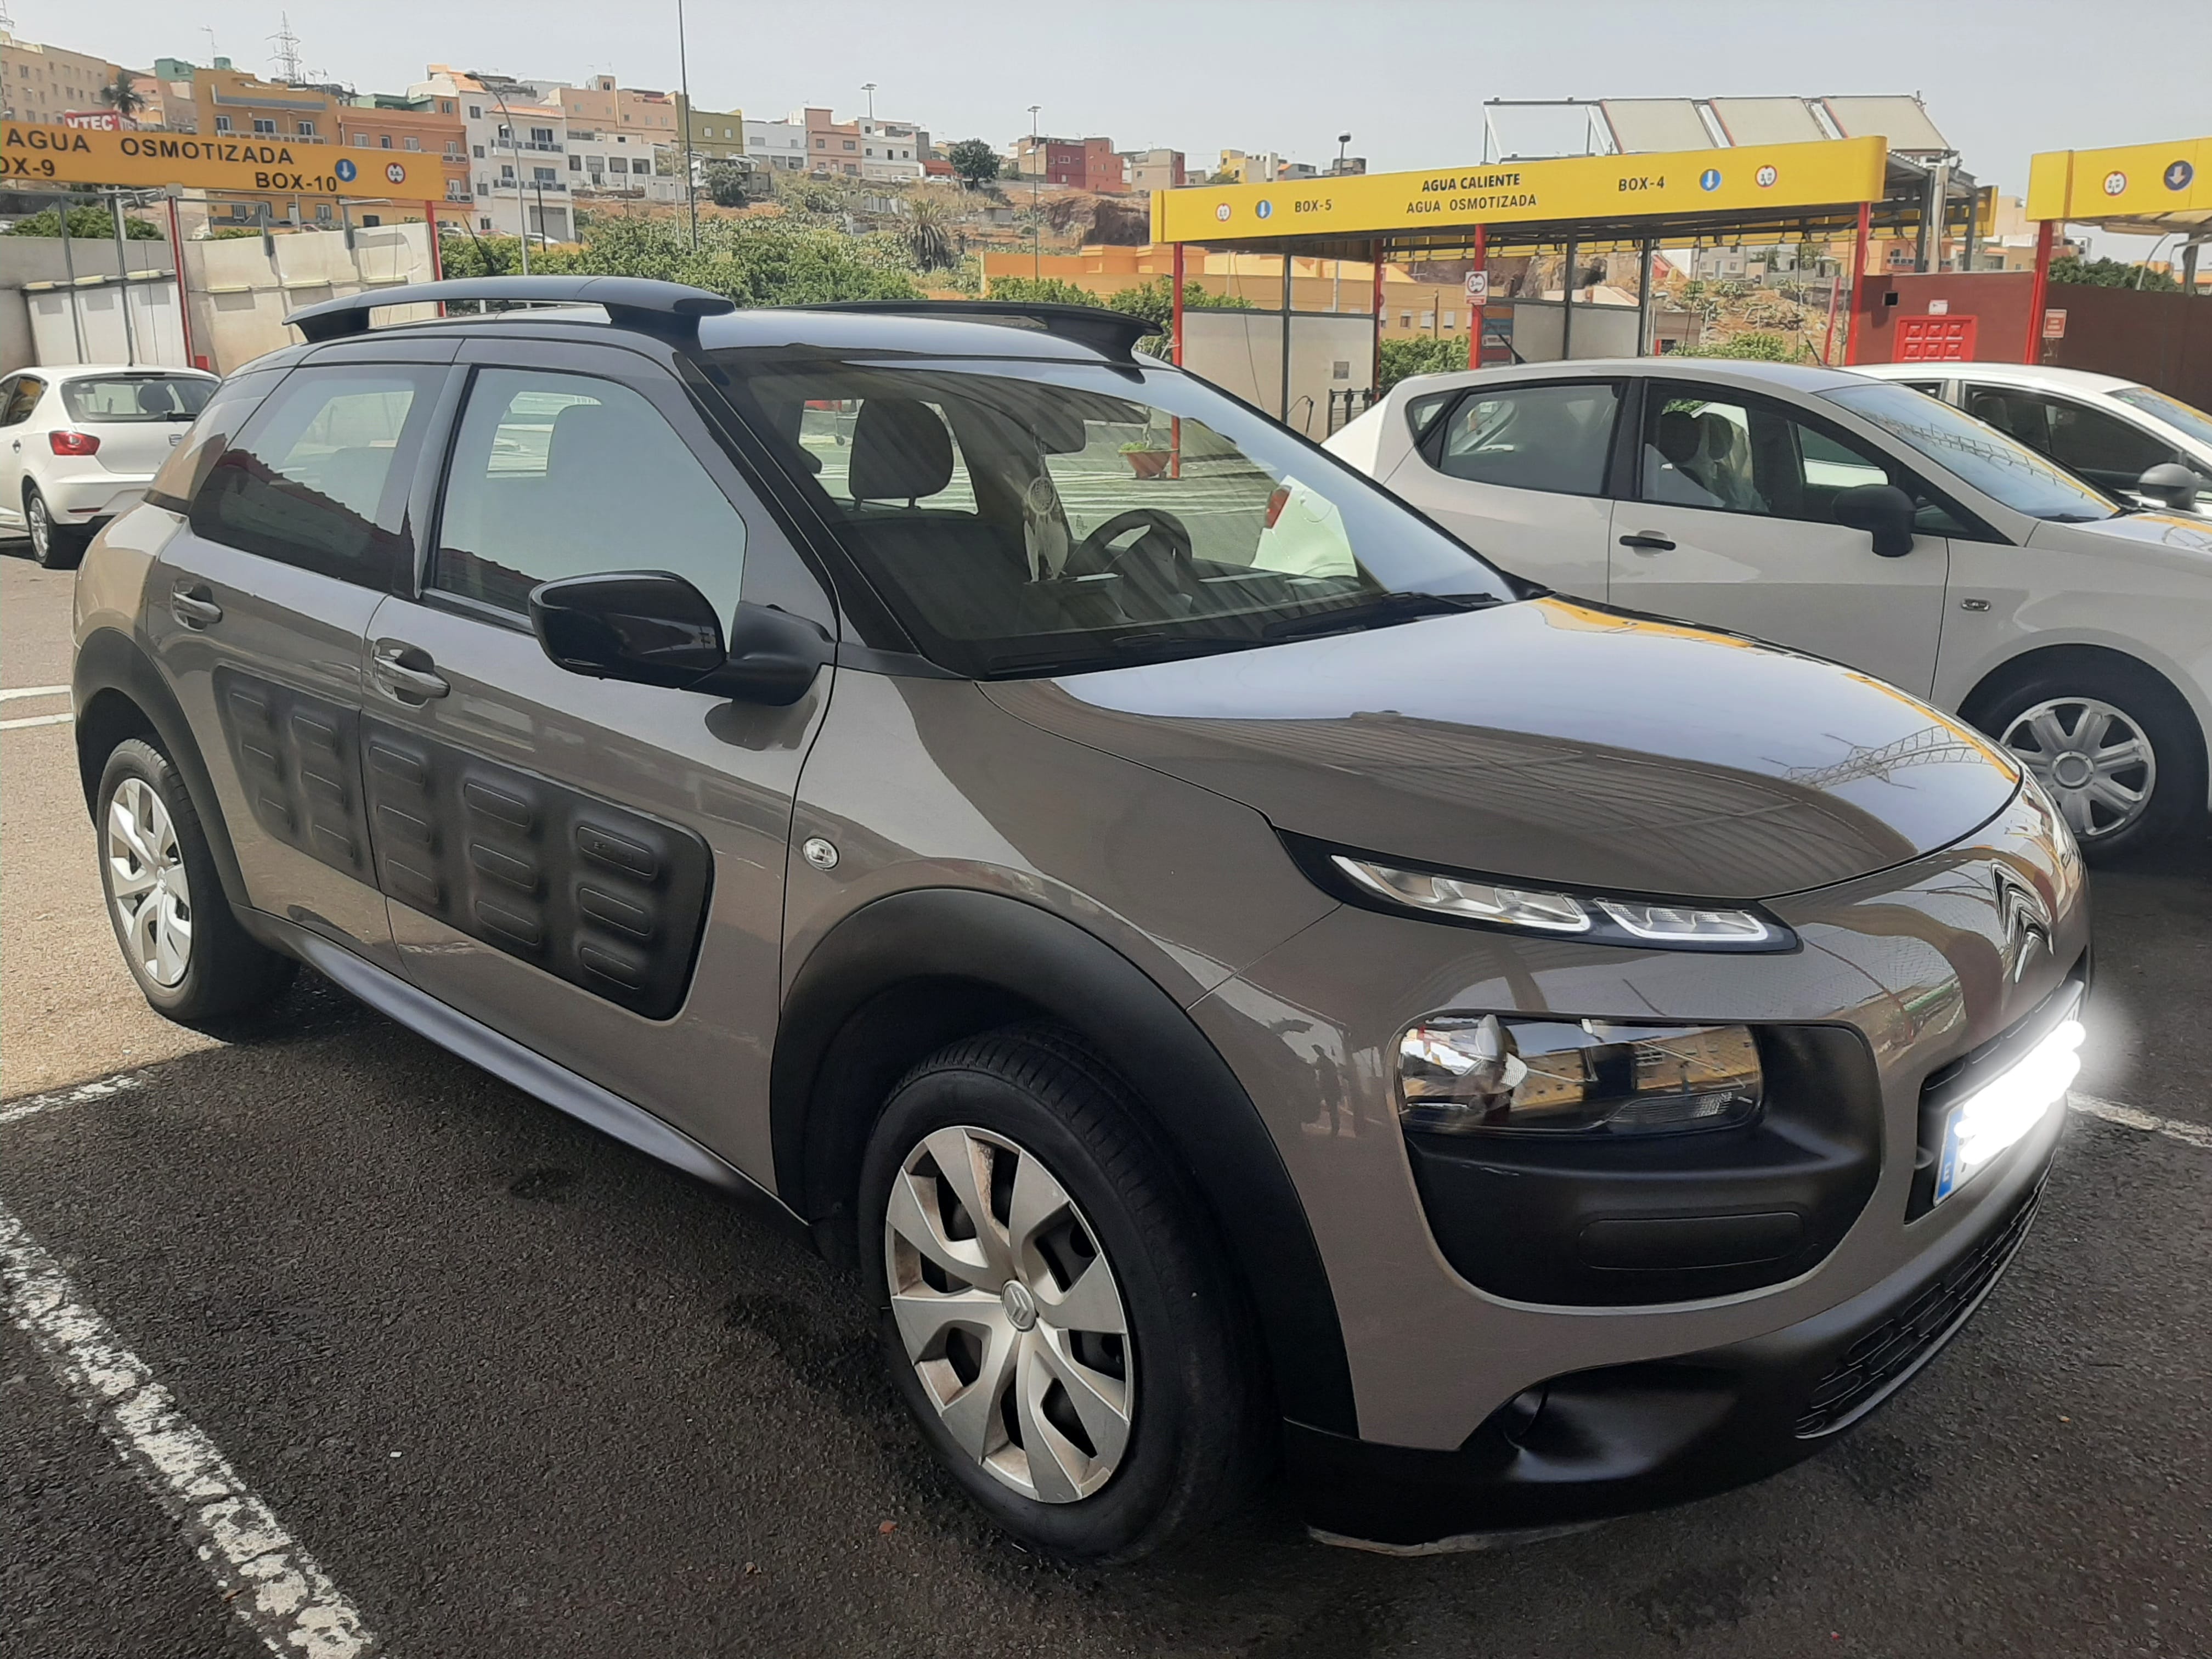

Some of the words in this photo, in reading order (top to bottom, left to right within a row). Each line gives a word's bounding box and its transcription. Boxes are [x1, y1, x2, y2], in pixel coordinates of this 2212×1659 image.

[6, 128, 91, 153] AGUA
[120, 137, 294, 165] OSMOTIZADA
[255, 172, 337, 192] BOX-10
[1422, 178, 1457, 192] AGUA
[1460, 173, 1520, 189] CALIENTE
[1618, 176, 1664, 191] BOX-4
[1295, 199, 1332, 212] BOX-5
[1406, 200, 1441, 214] AGUA
[1449, 193, 1537, 211] OSMOTIZADA
